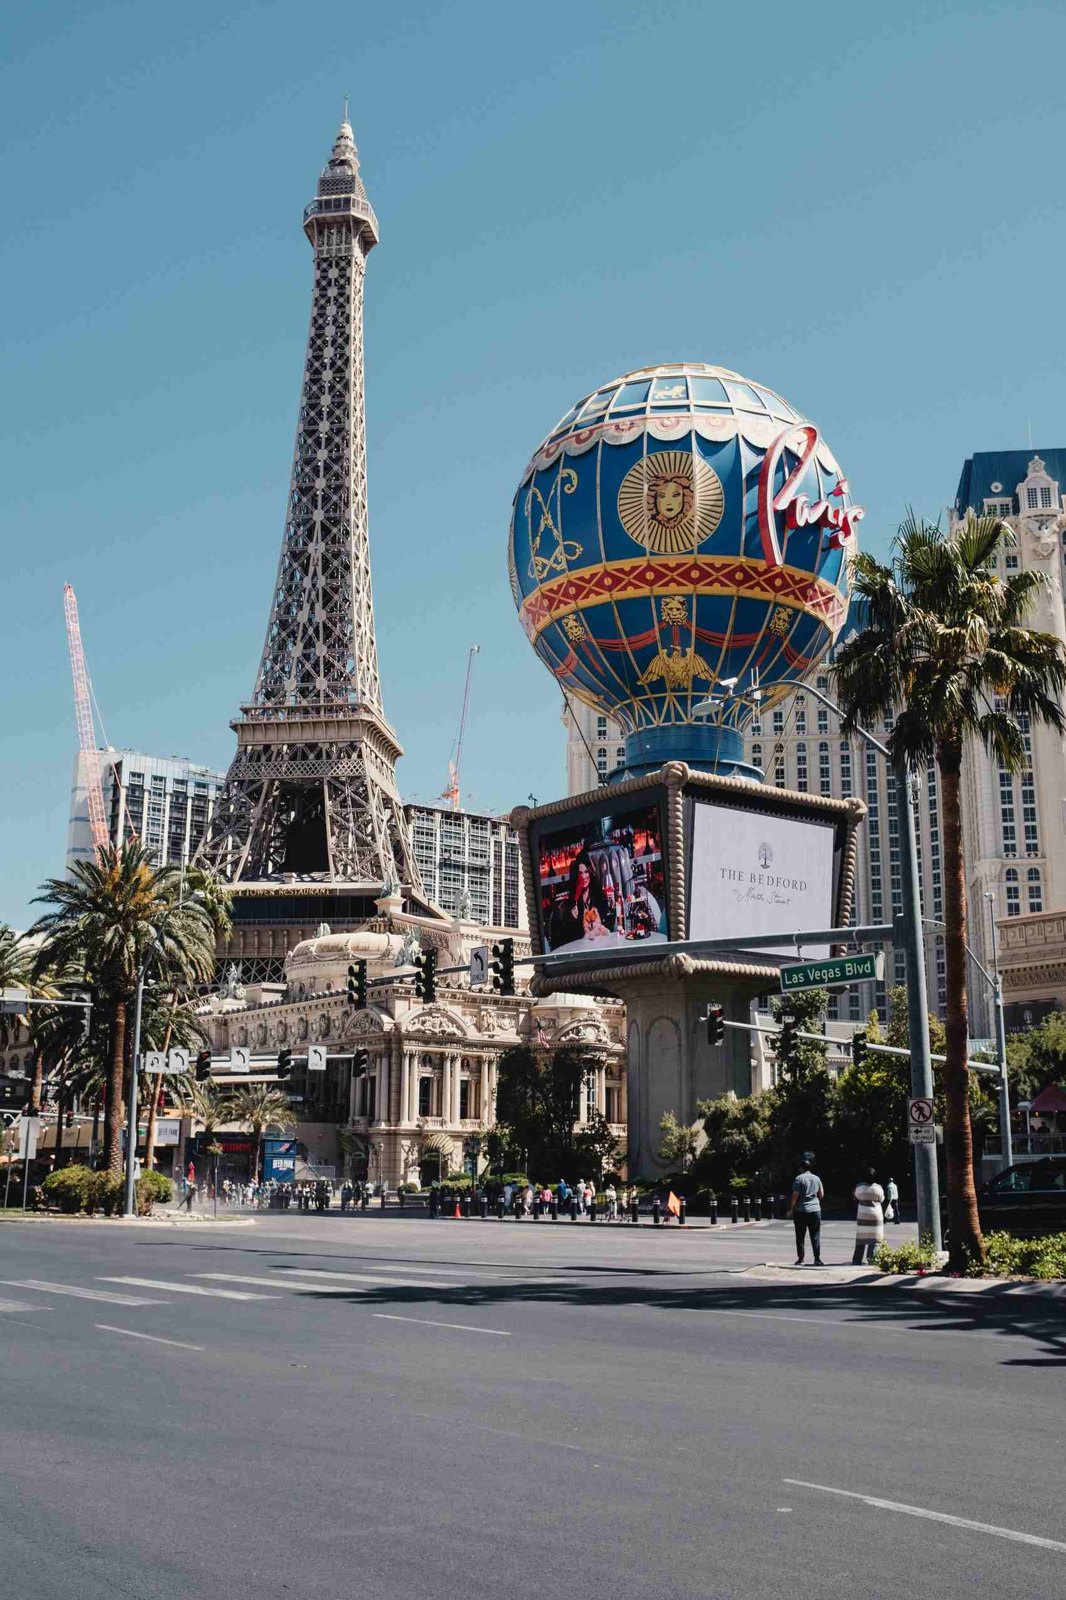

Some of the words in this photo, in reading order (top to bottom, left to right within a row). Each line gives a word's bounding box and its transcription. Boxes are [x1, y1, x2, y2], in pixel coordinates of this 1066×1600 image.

[758, 420, 866, 566] Paris
[719, 867, 744, 882] THE
[749, 872, 807, 891] BEDFORD
[246, 888, 275, 897] TOWER
[278, 886, 331, 896] RESTAURANT
[472, 974, 484, 982] ONLY
[784, 971, 804, 985] Las
[807, 966, 841, 983] Vegas
[845, 961, 872, 976] Blvd
